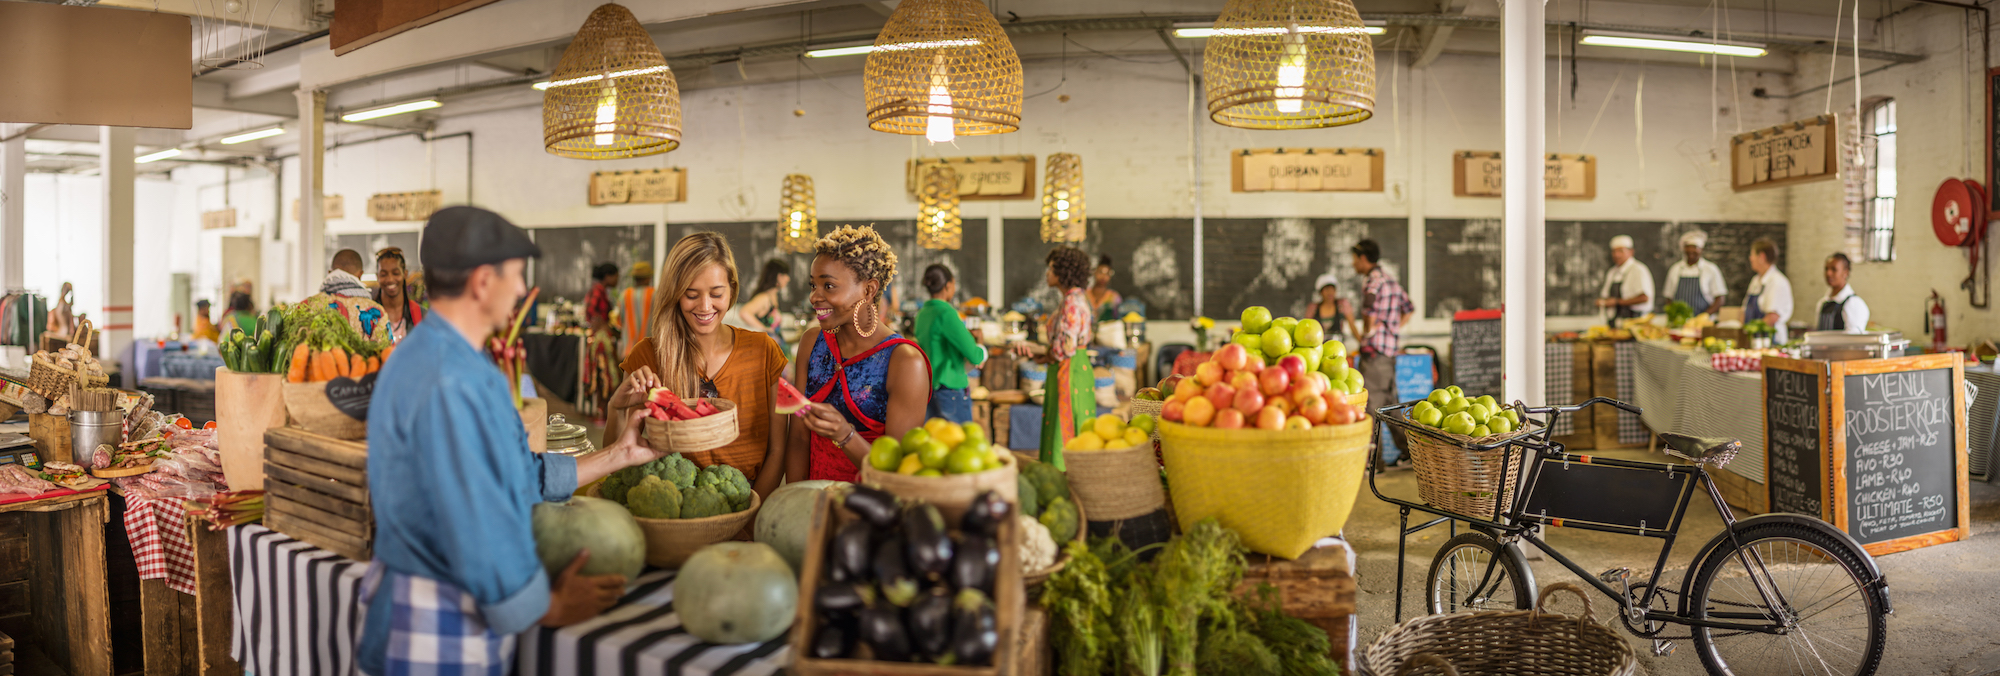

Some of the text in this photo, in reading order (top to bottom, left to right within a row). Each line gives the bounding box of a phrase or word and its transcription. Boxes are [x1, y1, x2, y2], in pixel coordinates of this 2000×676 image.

[1748, 132, 1813, 159] ROOSTERKOEK
[969, 171, 1012, 185] SPICES
[1268, 164, 1352, 178] DURBAN DELI
[1775, 370, 1809, 399] MENU
[1863, 372, 1931, 405] MENU
[1846, 395, 1953, 443] ROOSTERKOEK
[1854, 439, 1891, 458] CHEESE
[1856, 498, 1913, 521] ULTIMATE
